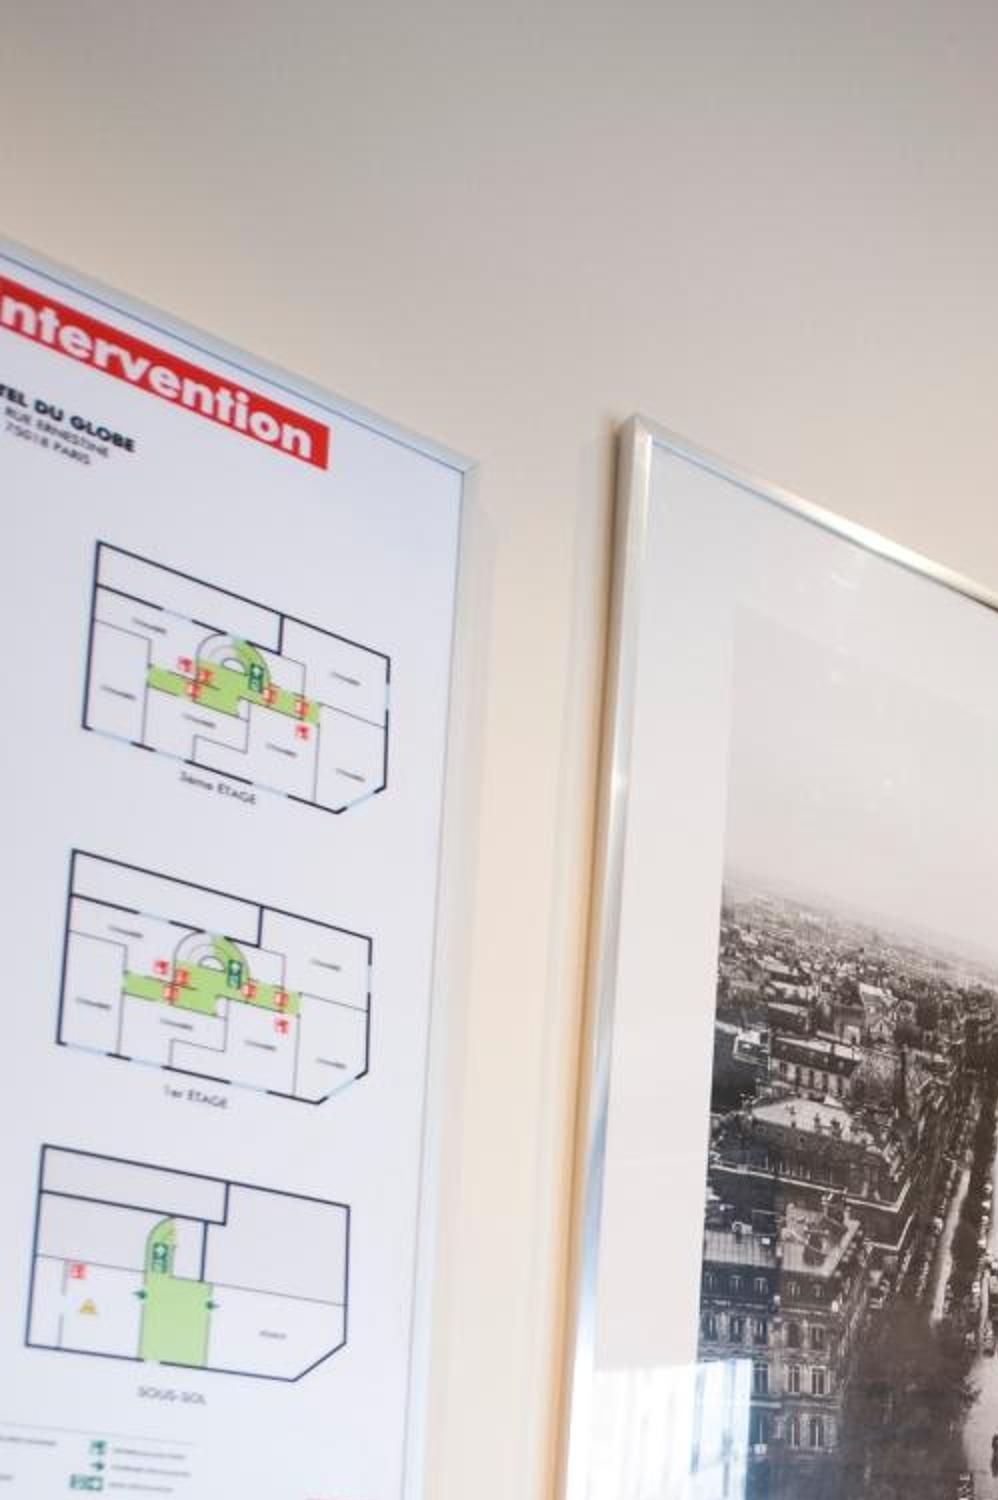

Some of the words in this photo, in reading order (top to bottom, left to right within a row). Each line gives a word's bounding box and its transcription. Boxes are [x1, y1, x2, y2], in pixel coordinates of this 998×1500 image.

[1, 294, 313, 460] ntervention
[34, 399, 64, 422] DU
[70, 415, 135, 453] GLOBE
